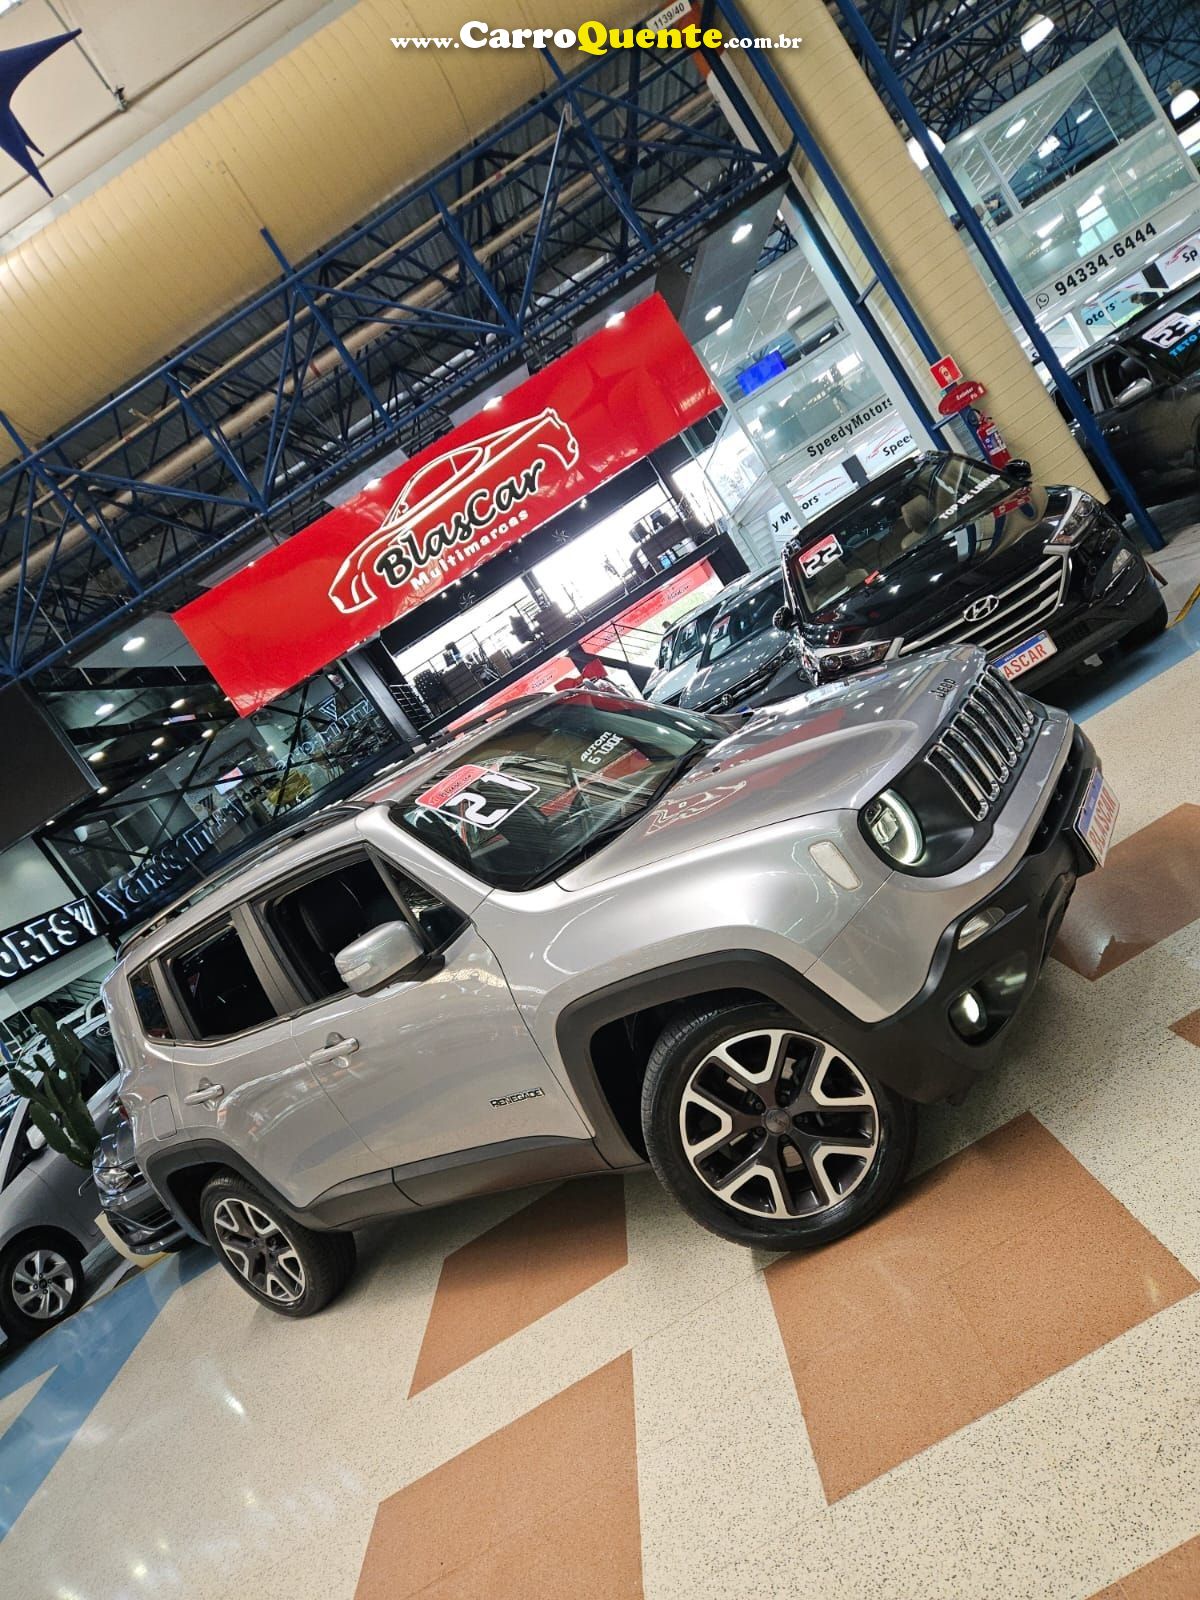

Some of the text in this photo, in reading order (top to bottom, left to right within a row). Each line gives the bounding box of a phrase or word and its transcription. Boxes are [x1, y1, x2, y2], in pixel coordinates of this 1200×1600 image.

[653, 2, 685, 30] 1139/40
[1054, 222, 1157, 296] 94334-6444
[1151, 317, 1194, 346] 23
[374, 459, 545, 588] BlasCar
[939, 503, 958, 520] TOP
[410, 509, 529, 590] Multimarcas
[803, 543, 841, 574] 22
[1003, 643, 1047, 678] ASCAR
[446, 773, 533, 824] 21
[490, 1087, 545, 1107] RENEGADE
